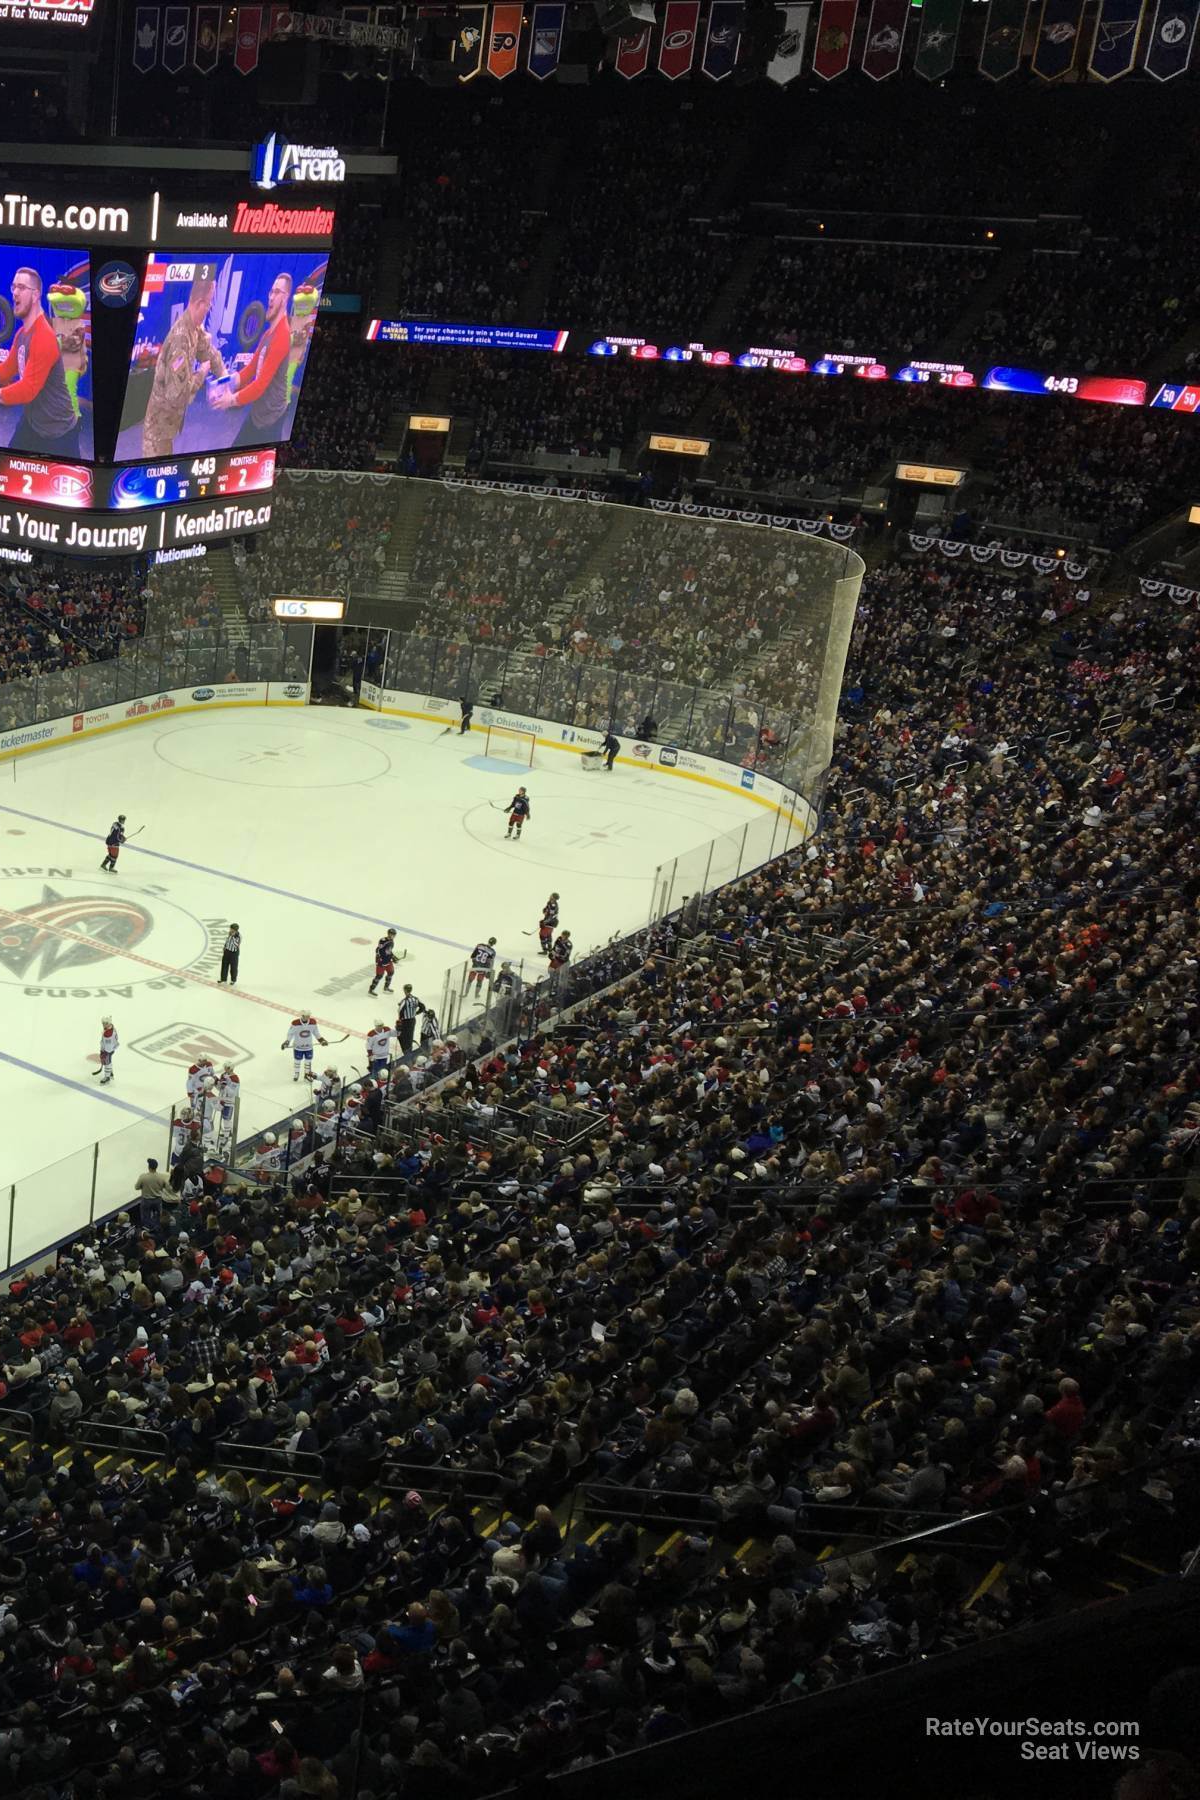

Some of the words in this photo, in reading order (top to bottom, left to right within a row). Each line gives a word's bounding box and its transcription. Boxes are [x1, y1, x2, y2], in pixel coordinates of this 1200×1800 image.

[11, 6, 25, 19] for
[28, 8, 49, 20] Your
[51, 11, 88, 26] Journey
[298, 145, 338, 158] Nationwide
[278, 144, 345, 181] Arena
[176, 212, 218, 228] Available
[219, 213, 228, 228] at
[233, 202, 335, 234] TireDiscounters
[170, 265, 191, 280] 04.6
[201, 265, 209, 280] 3
[414, 334, 436, 342] signed
[437, 335, 474, 344] game-used
[426, 327, 441, 335] your
[496, 330, 514, 338] David
[515, 332, 538, 340] Savard
[606, 336, 645, 346] TAKEAWAYS
[689, 343, 703, 351] HITS
[612, 345, 618, 354] 9
[631, 346, 637, 356] 5
[682, 351, 692, 361] 10
[701, 352, 712, 362] 10
[750, 347, 773, 356] POWER
[774, 349, 795, 358] PLAYS
[751, 357, 768, 367] 0/2
[773, 358, 790, 368] 0/2
[825, 354, 854, 363] BLOCKED
[855, 356, 876, 364] SHOTS
[837, 364, 844, 374] 6
[858, 365, 864, 374] 4
[910, 361, 944, 371] FACEOFFS
[946, 364, 964, 372] WON
[918, 371, 930, 381] 16
[940, 372, 952, 383] 21
[1043, 376, 1079, 394] 4:43
[1162, 390, 1174, 403] 50
[1183, 392, 1196, 405] 50
[9, 460, 49, 475] MONTREAL
[191, 457, 216, 477] 4:43
[229, 456, 258, 467] MONTREAL
[146, 464, 178, 479] COLUMBUS
[238, 469, 247, 487] 2
[22, 475, 32, 495] 2
[156, 480, 165, 499] 0
[200, 485, 206, 495] 2
[16, 511, 60, 543] Your
[65, 521, 147, 550] Journey
[155, 543, 207, 564] Nationwide
[281, 602, 307, 615] IGS
[86, 713, 109, 724] TOYOTA
[496, 717, 543, 734] OhioHealth
[0, 727, 54, 749] ticketmaster
[661, 751, 676, 761] FOX
[146, 918, 229, 990] Nationwide
[476, 949, 489, 964] 28
[23, 985, 134, 999] Arena
[141, 1026, 200, 1053] MARATHON
